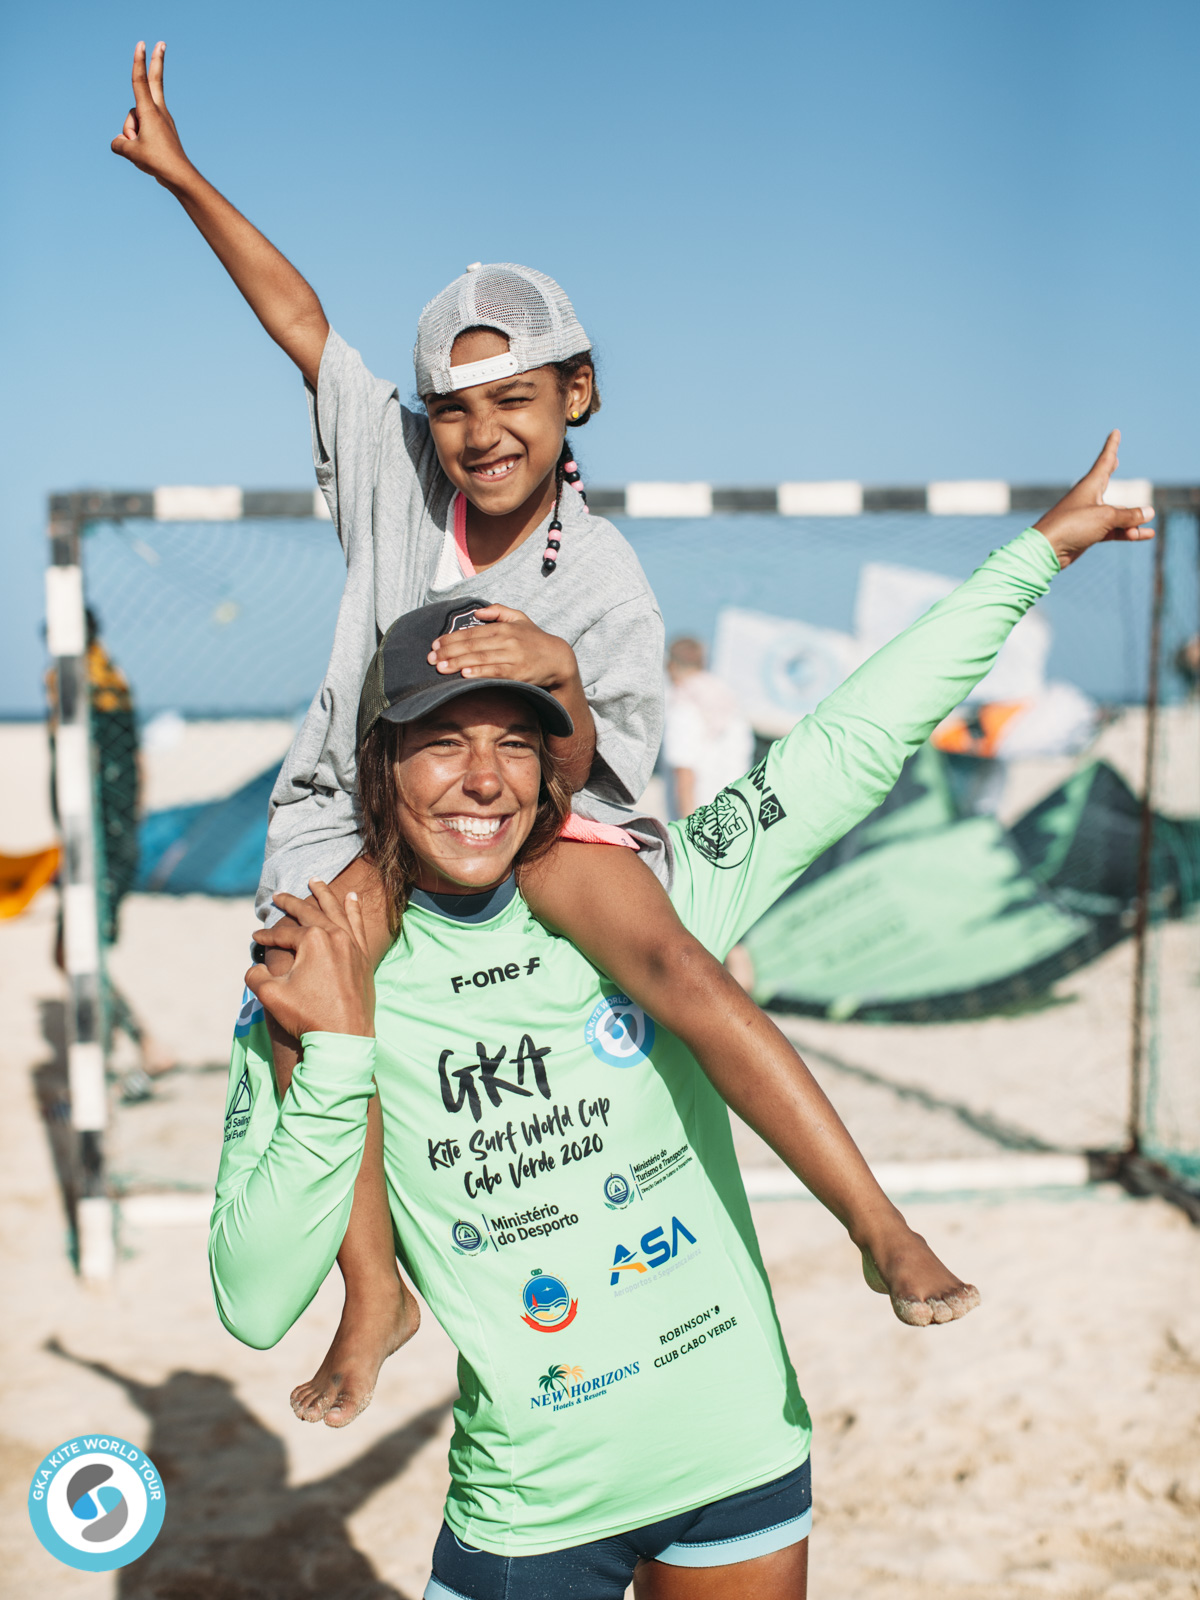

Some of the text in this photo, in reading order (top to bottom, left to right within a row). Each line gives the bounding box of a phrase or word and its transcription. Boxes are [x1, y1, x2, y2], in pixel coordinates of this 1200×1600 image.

[586, 997, 629, 1042] KA KITE WORLD
[438, 1034, 552, 1123] GKA
[427, 1097, 611, 1171] Kite Surf World Cup
[463, 1133, 604, 1199] Cabo Verde 2020
[633, 1149, 668, 1173] Ministério do
[635, 1165, 659, 1182] Turismo
[661, 1144, 688, 1164] Transportes
[490, 1203, 560, 1232] Ministério
[497, 1231, 517, 1246] do
[516, 1213, 580, 1241] Desporto
[608, 1215, 698, 1287] ASA
[613, 1277, 653, 1298] Aeroportos
[652, 1273, 658, 1281] e
[653, 1316, 738, 1368] CLUB CABO VERDE
[530, 1361, 641, 1409] NEW HORIZONS
[552, 1400, 575, 1412] Hotels
[583, 1389, 607, 1402] Resorts
